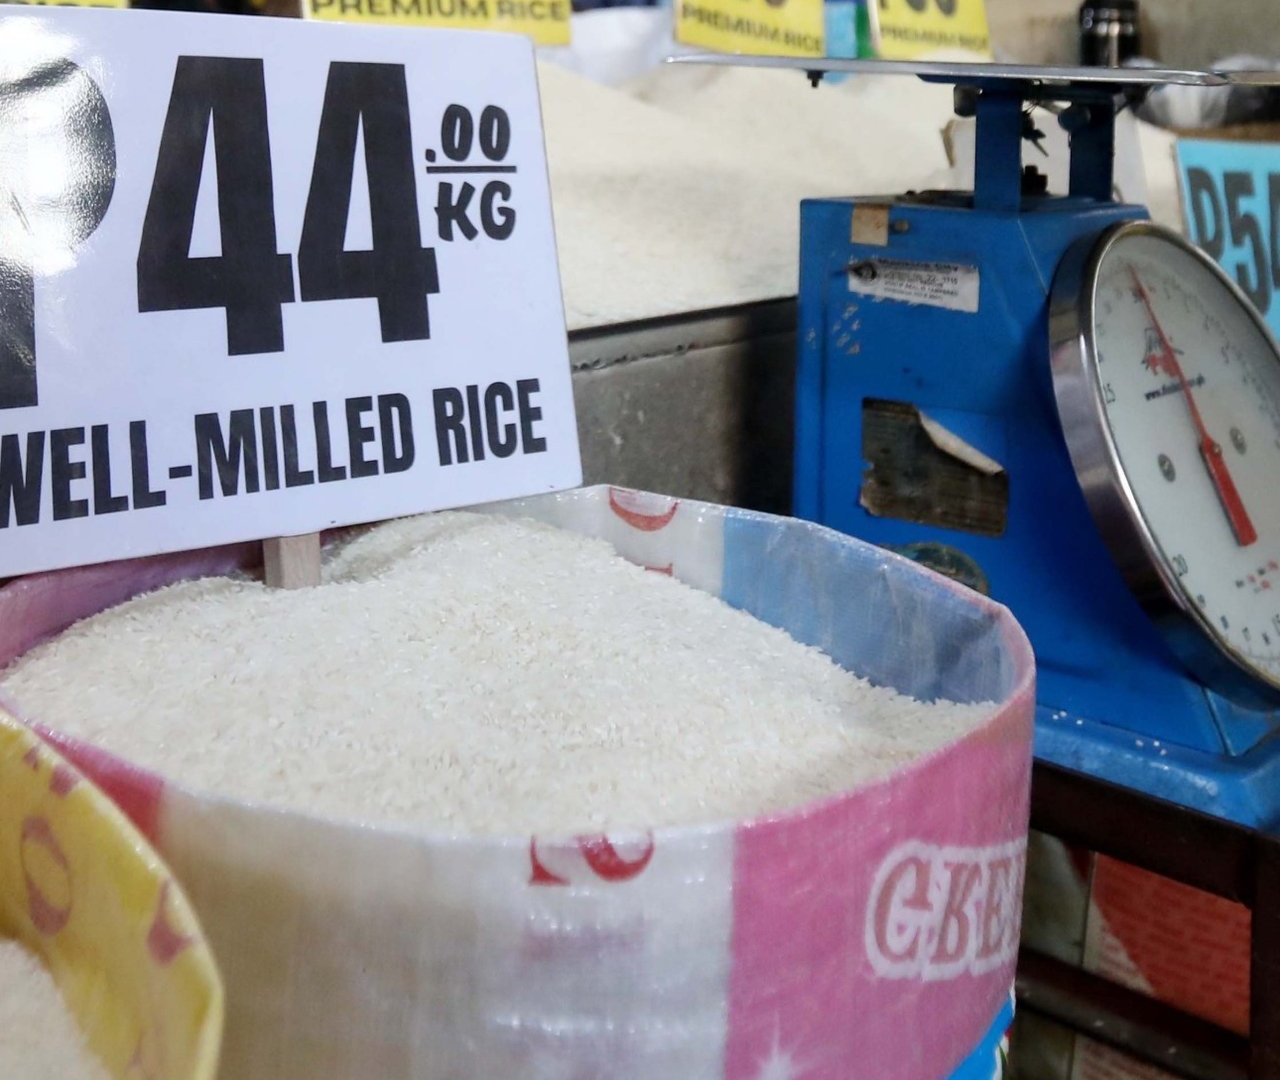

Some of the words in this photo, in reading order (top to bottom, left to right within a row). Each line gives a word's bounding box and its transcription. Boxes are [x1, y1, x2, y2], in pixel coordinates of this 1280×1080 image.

[496, 0, 566, 22] RICE
[681, 3, 782, 44] PREMIUM
[783, 30, 823, 53] RICE
[425, 104, 511, 164] .00
[434, 180, 516, 241] KG
[432, 377, 548, 466] RICE
